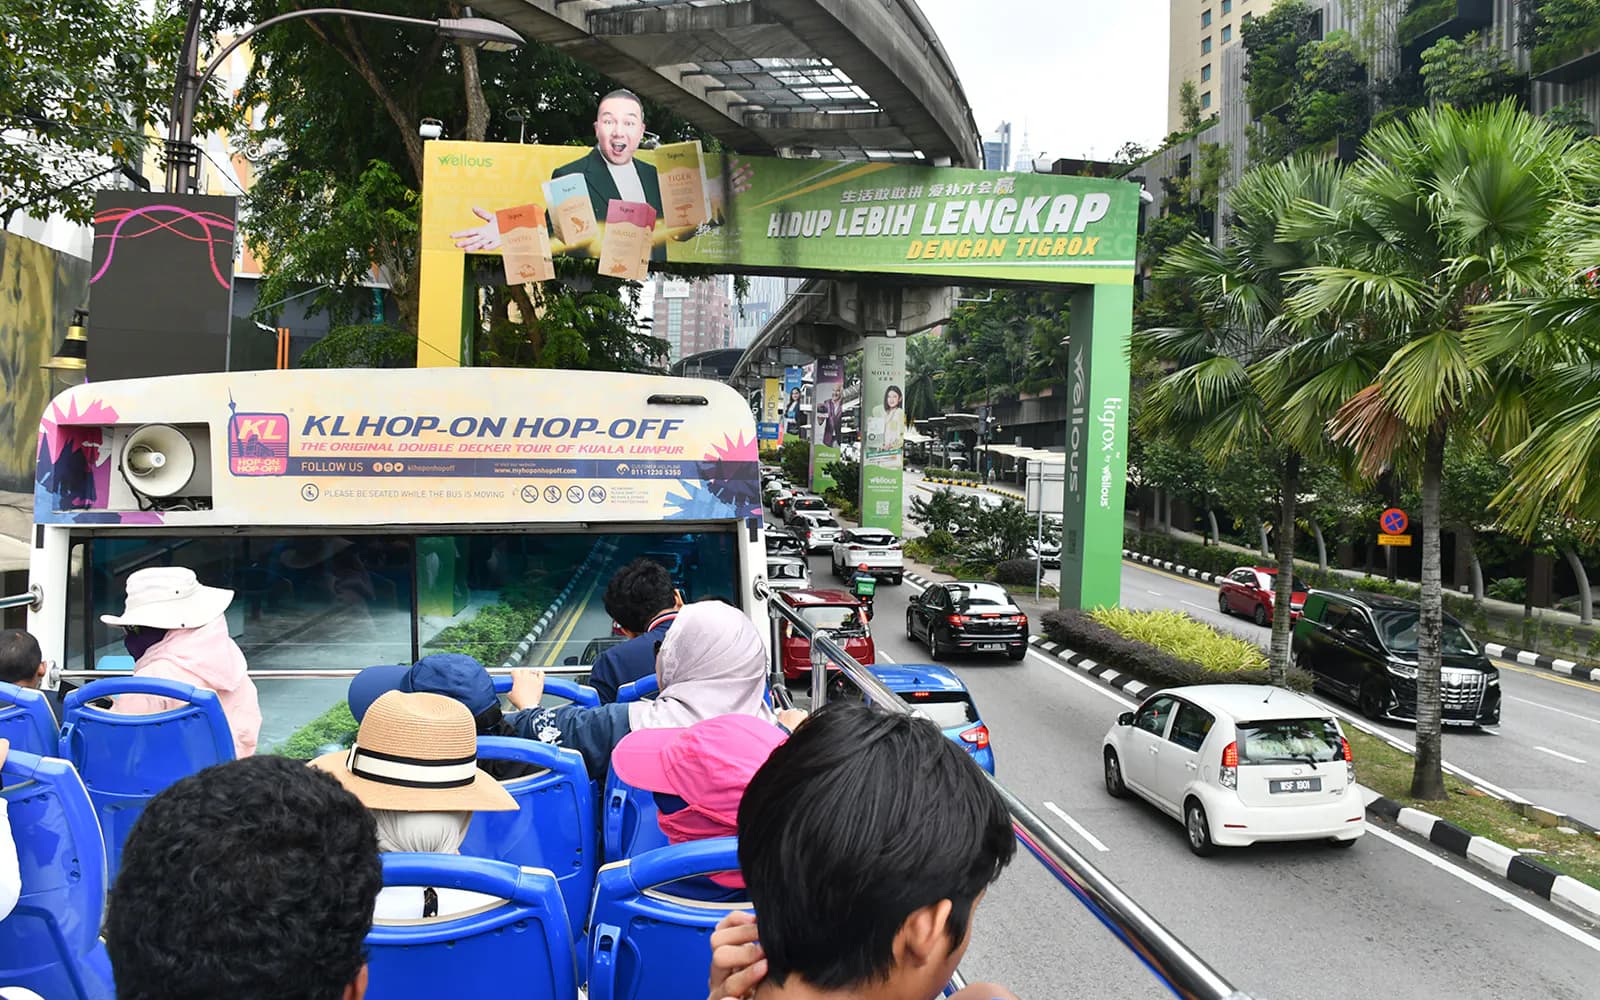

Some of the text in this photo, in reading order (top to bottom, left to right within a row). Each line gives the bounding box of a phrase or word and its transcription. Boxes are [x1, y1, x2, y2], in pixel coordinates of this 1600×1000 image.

[767, 193, 1110, 238] HIDUP LEBIH LENGKAP
[905, 238, 1007, 260] DENGAN
[1015, 237, 1101, 257] TIGROX
[238, 419, 281, 440] KL
[302, 415, 684, 440] KL HOP-ON HOP-OFF
[300, 442, 684, 455] THE ORIGINAL DOUBLE DECKER TOUR OF KUALA LUMPUR
[238, 458, 280, 466] HOP-ON
[301, 462, 364, 472] FOLLOW US
[494, 467, 577, 475] www.myhoponhopoff.com
[324, 489, 505, 498] PLEASE BE SEATED WHILE THE BUS IS MOVING
